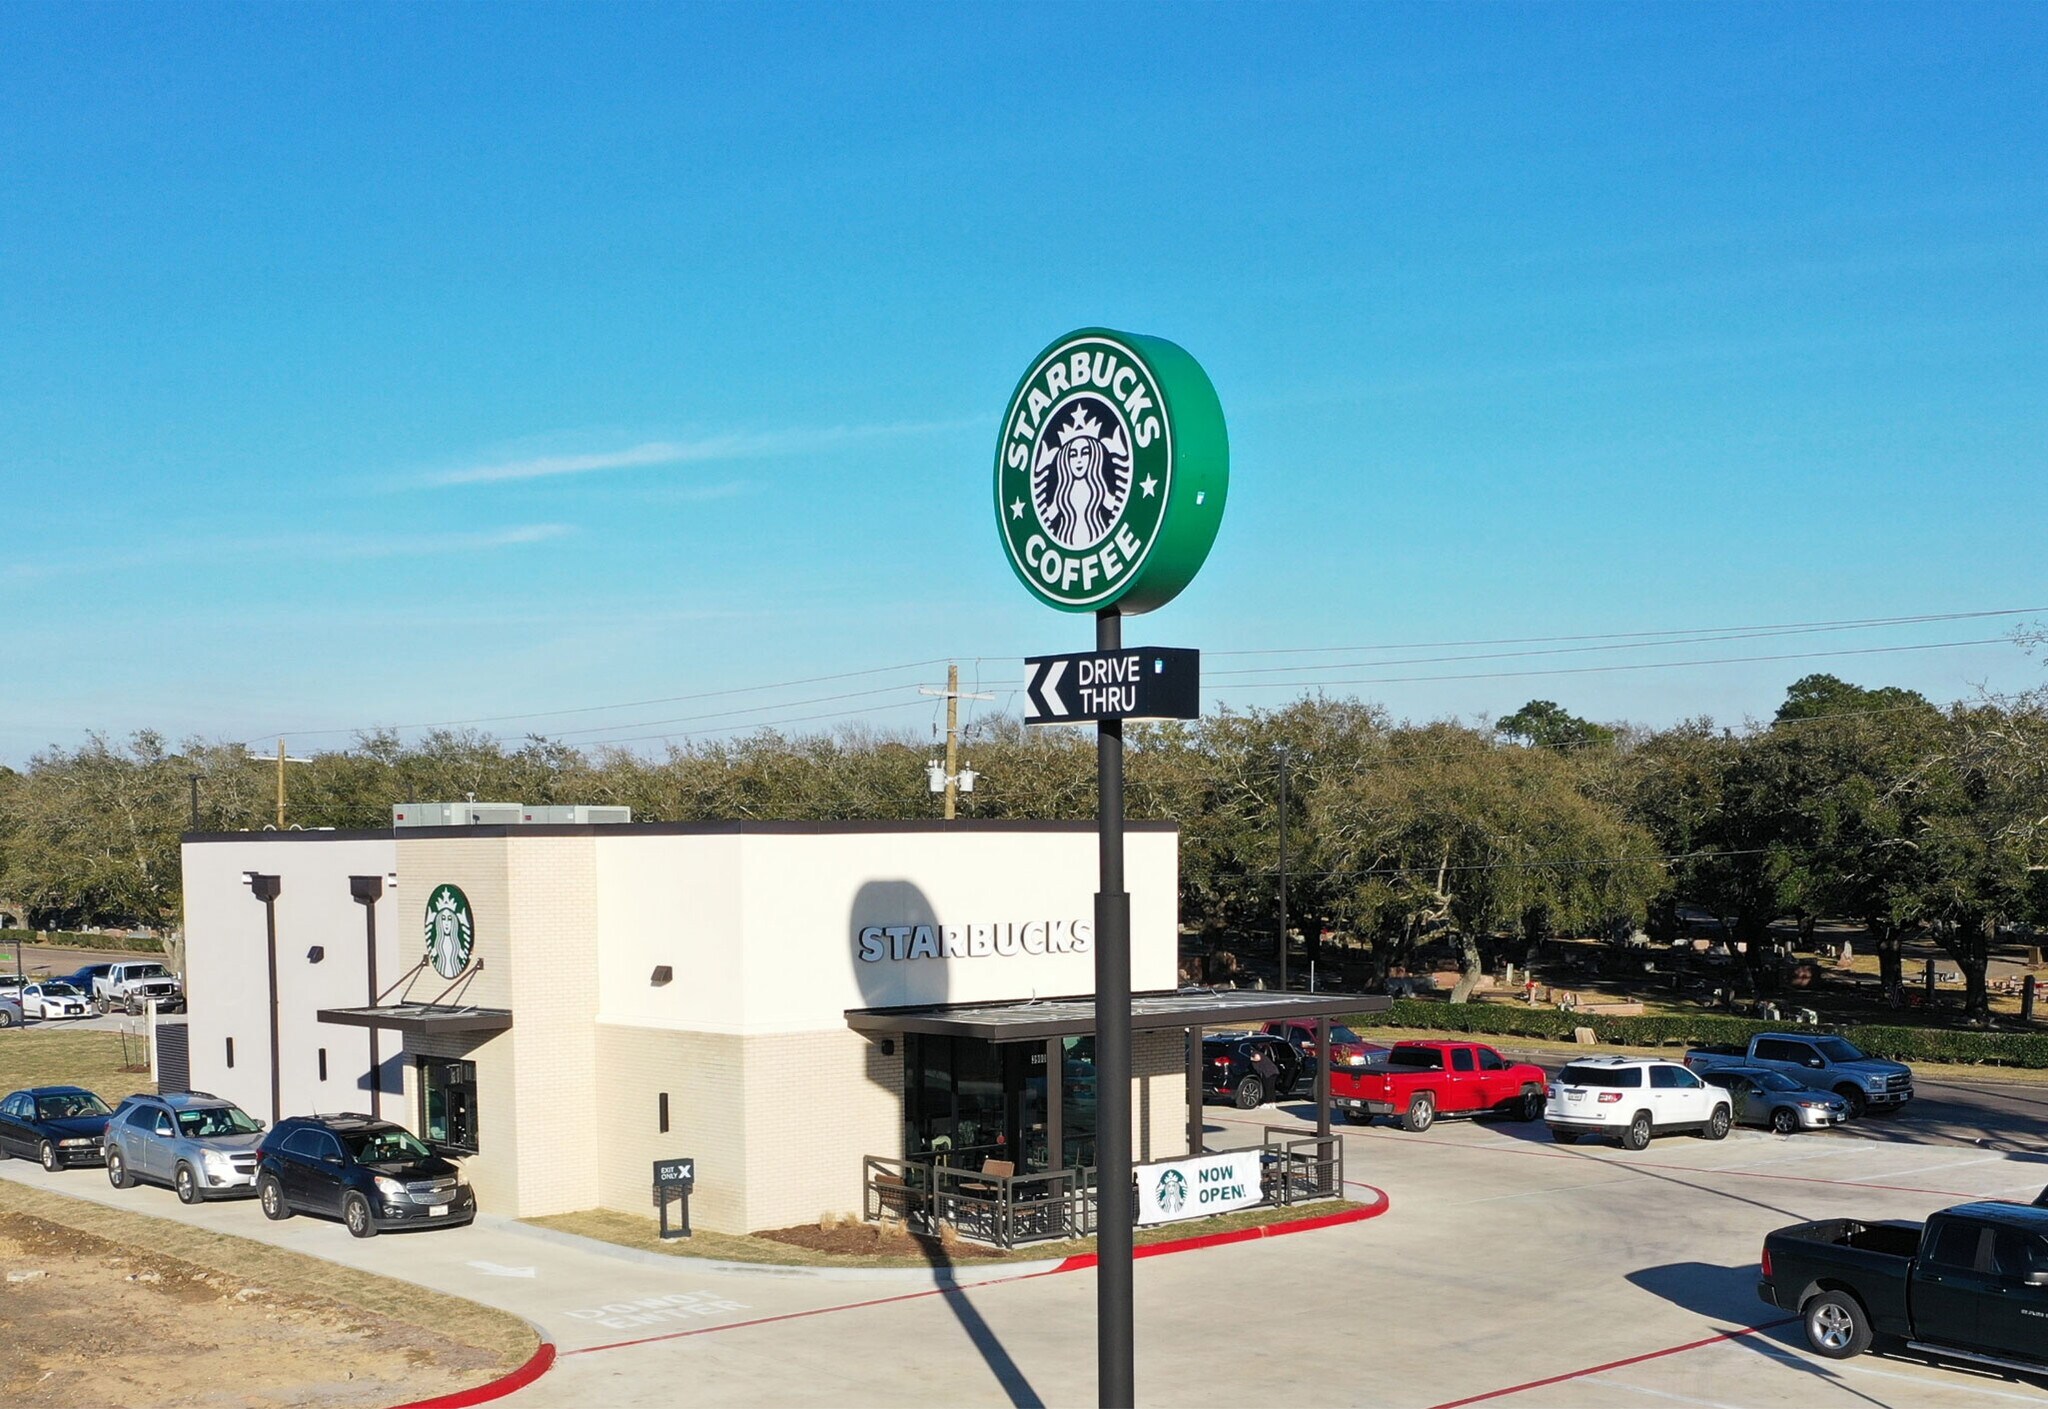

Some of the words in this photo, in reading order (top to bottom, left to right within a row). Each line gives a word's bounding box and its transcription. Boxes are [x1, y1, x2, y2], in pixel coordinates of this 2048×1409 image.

[1008, 352, 1160, 471] STARBUCKS
[1025, 522, 1142, 591] COFFEE
[1079, 656, 1140, 685] DRIVE
[1079, 685, 1136, 714] THRU
[859, 919, 1093, 963] STARBUCKS
[1199, 1165, 1233, 1183] NOW
[1199, 1184, 1247, 1203] OPEN!
[562, 1304, 641, 1319] DO
[634, 1290, 722, 1309] NOT
[596, 1300, 753, 1328] ENTER
